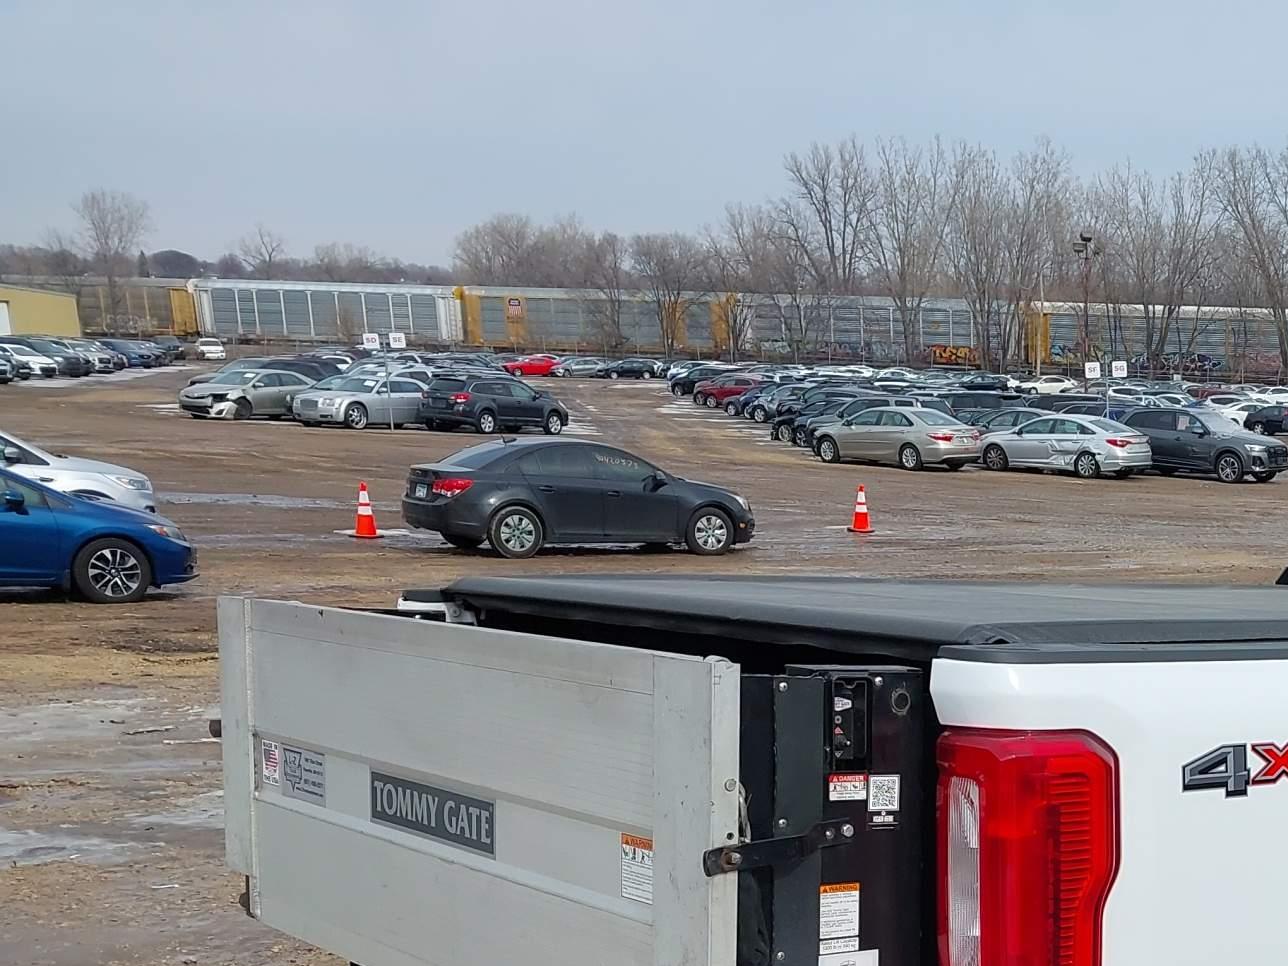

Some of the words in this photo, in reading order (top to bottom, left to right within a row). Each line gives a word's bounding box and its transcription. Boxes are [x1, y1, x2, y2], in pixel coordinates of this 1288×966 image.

[373, 780, 439, 827] TOMMY
[443, 800, 491, 844] GATE
[829, 884, 857, 892] WARNING
